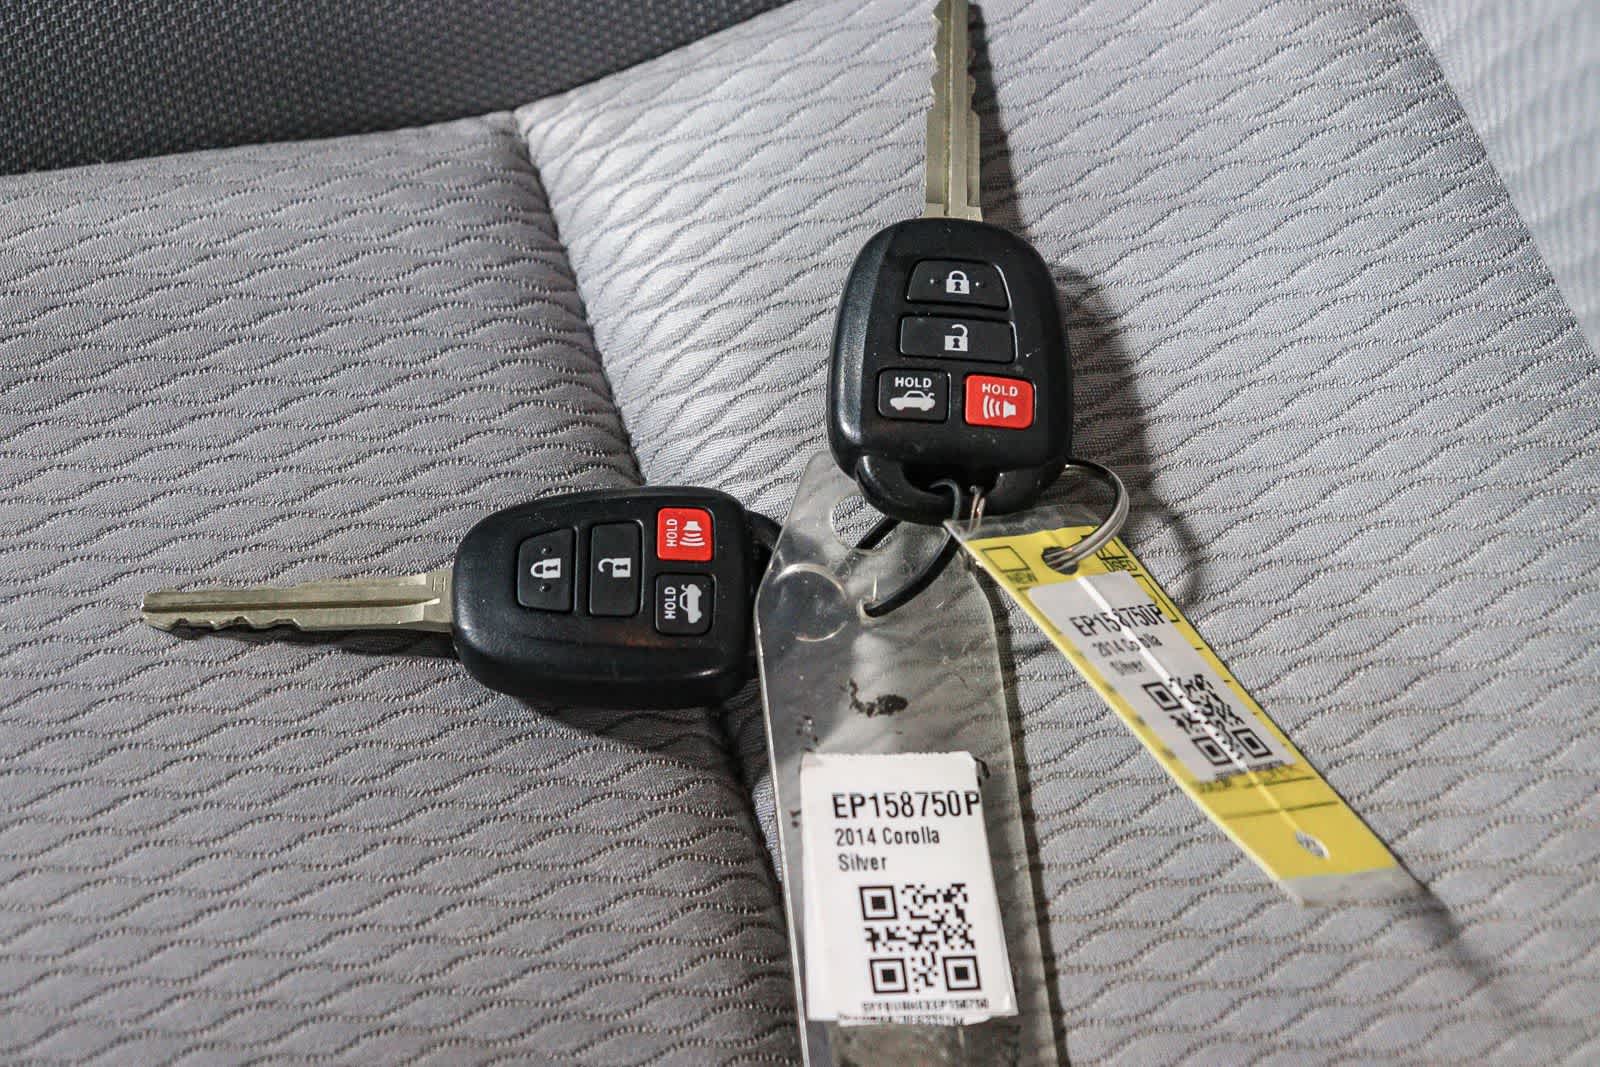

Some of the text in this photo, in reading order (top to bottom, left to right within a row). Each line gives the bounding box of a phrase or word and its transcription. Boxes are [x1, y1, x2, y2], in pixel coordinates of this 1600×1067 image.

[894, 376, 932, 389] HOLD
[981, 383, 1018, 397] HOLD
[666, 518, 678, 547] HOLD
[664, 586, 677, 620] HOLD
[1069, 603, 1165, 637] EP158750P
[1120, 633, 1163, 652] Coolla
[832, 789, 980, 819] EP158750P
[834, 825, 941, 847] 2014 Corolla
[838, 853, 888, 873] Silver
